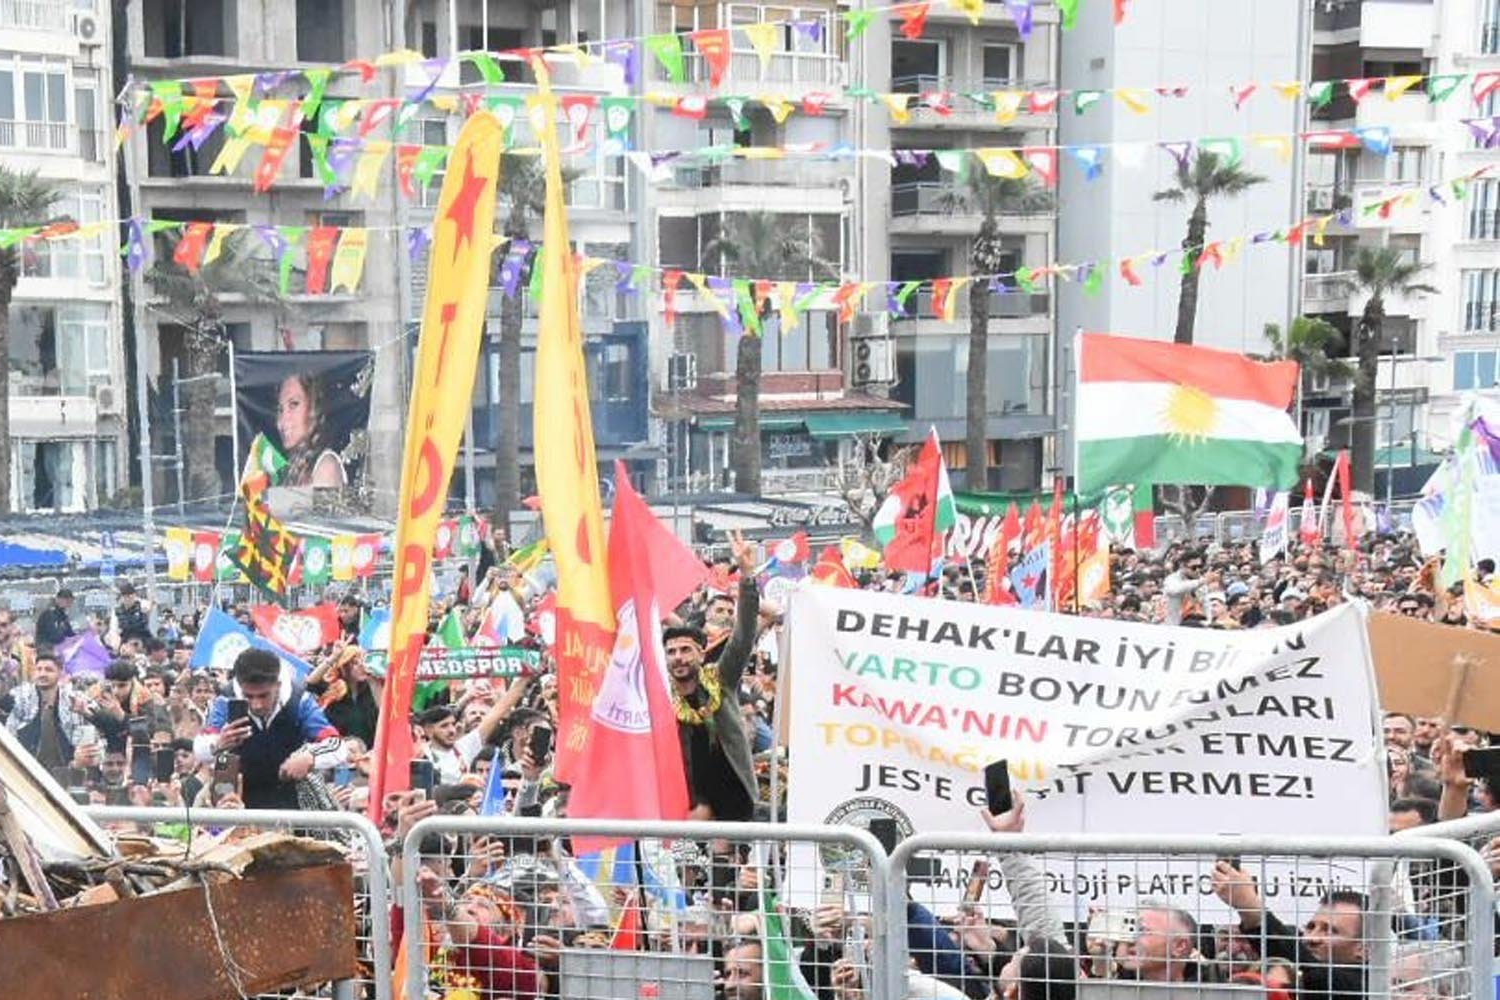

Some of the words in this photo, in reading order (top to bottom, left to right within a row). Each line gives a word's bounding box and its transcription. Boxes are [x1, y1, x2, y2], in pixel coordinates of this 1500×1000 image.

[416, 656, 523, 677] MEDSPOR
[835, 608, 1101, 666] DEHAK'LAR
[1114, 635, 1176, 673] İYİ
[833, 647, 983, 691] VARTO
[997, 671, 1161, 712] BOYUN
[832, 682, 1048, 743] KAWA'NIN
[1063, 694, 1336, 749] TORUNLARI
[814, 720, 1046, 782] TOPRAĞNI
[1201, 731, 1357, 763] ETMEZ
[854, 763, 952, 801] JES'E
[1107, 770, 1315, 800] VERMEZ!
[1118, 873, 1279, 897] PLATFOU
